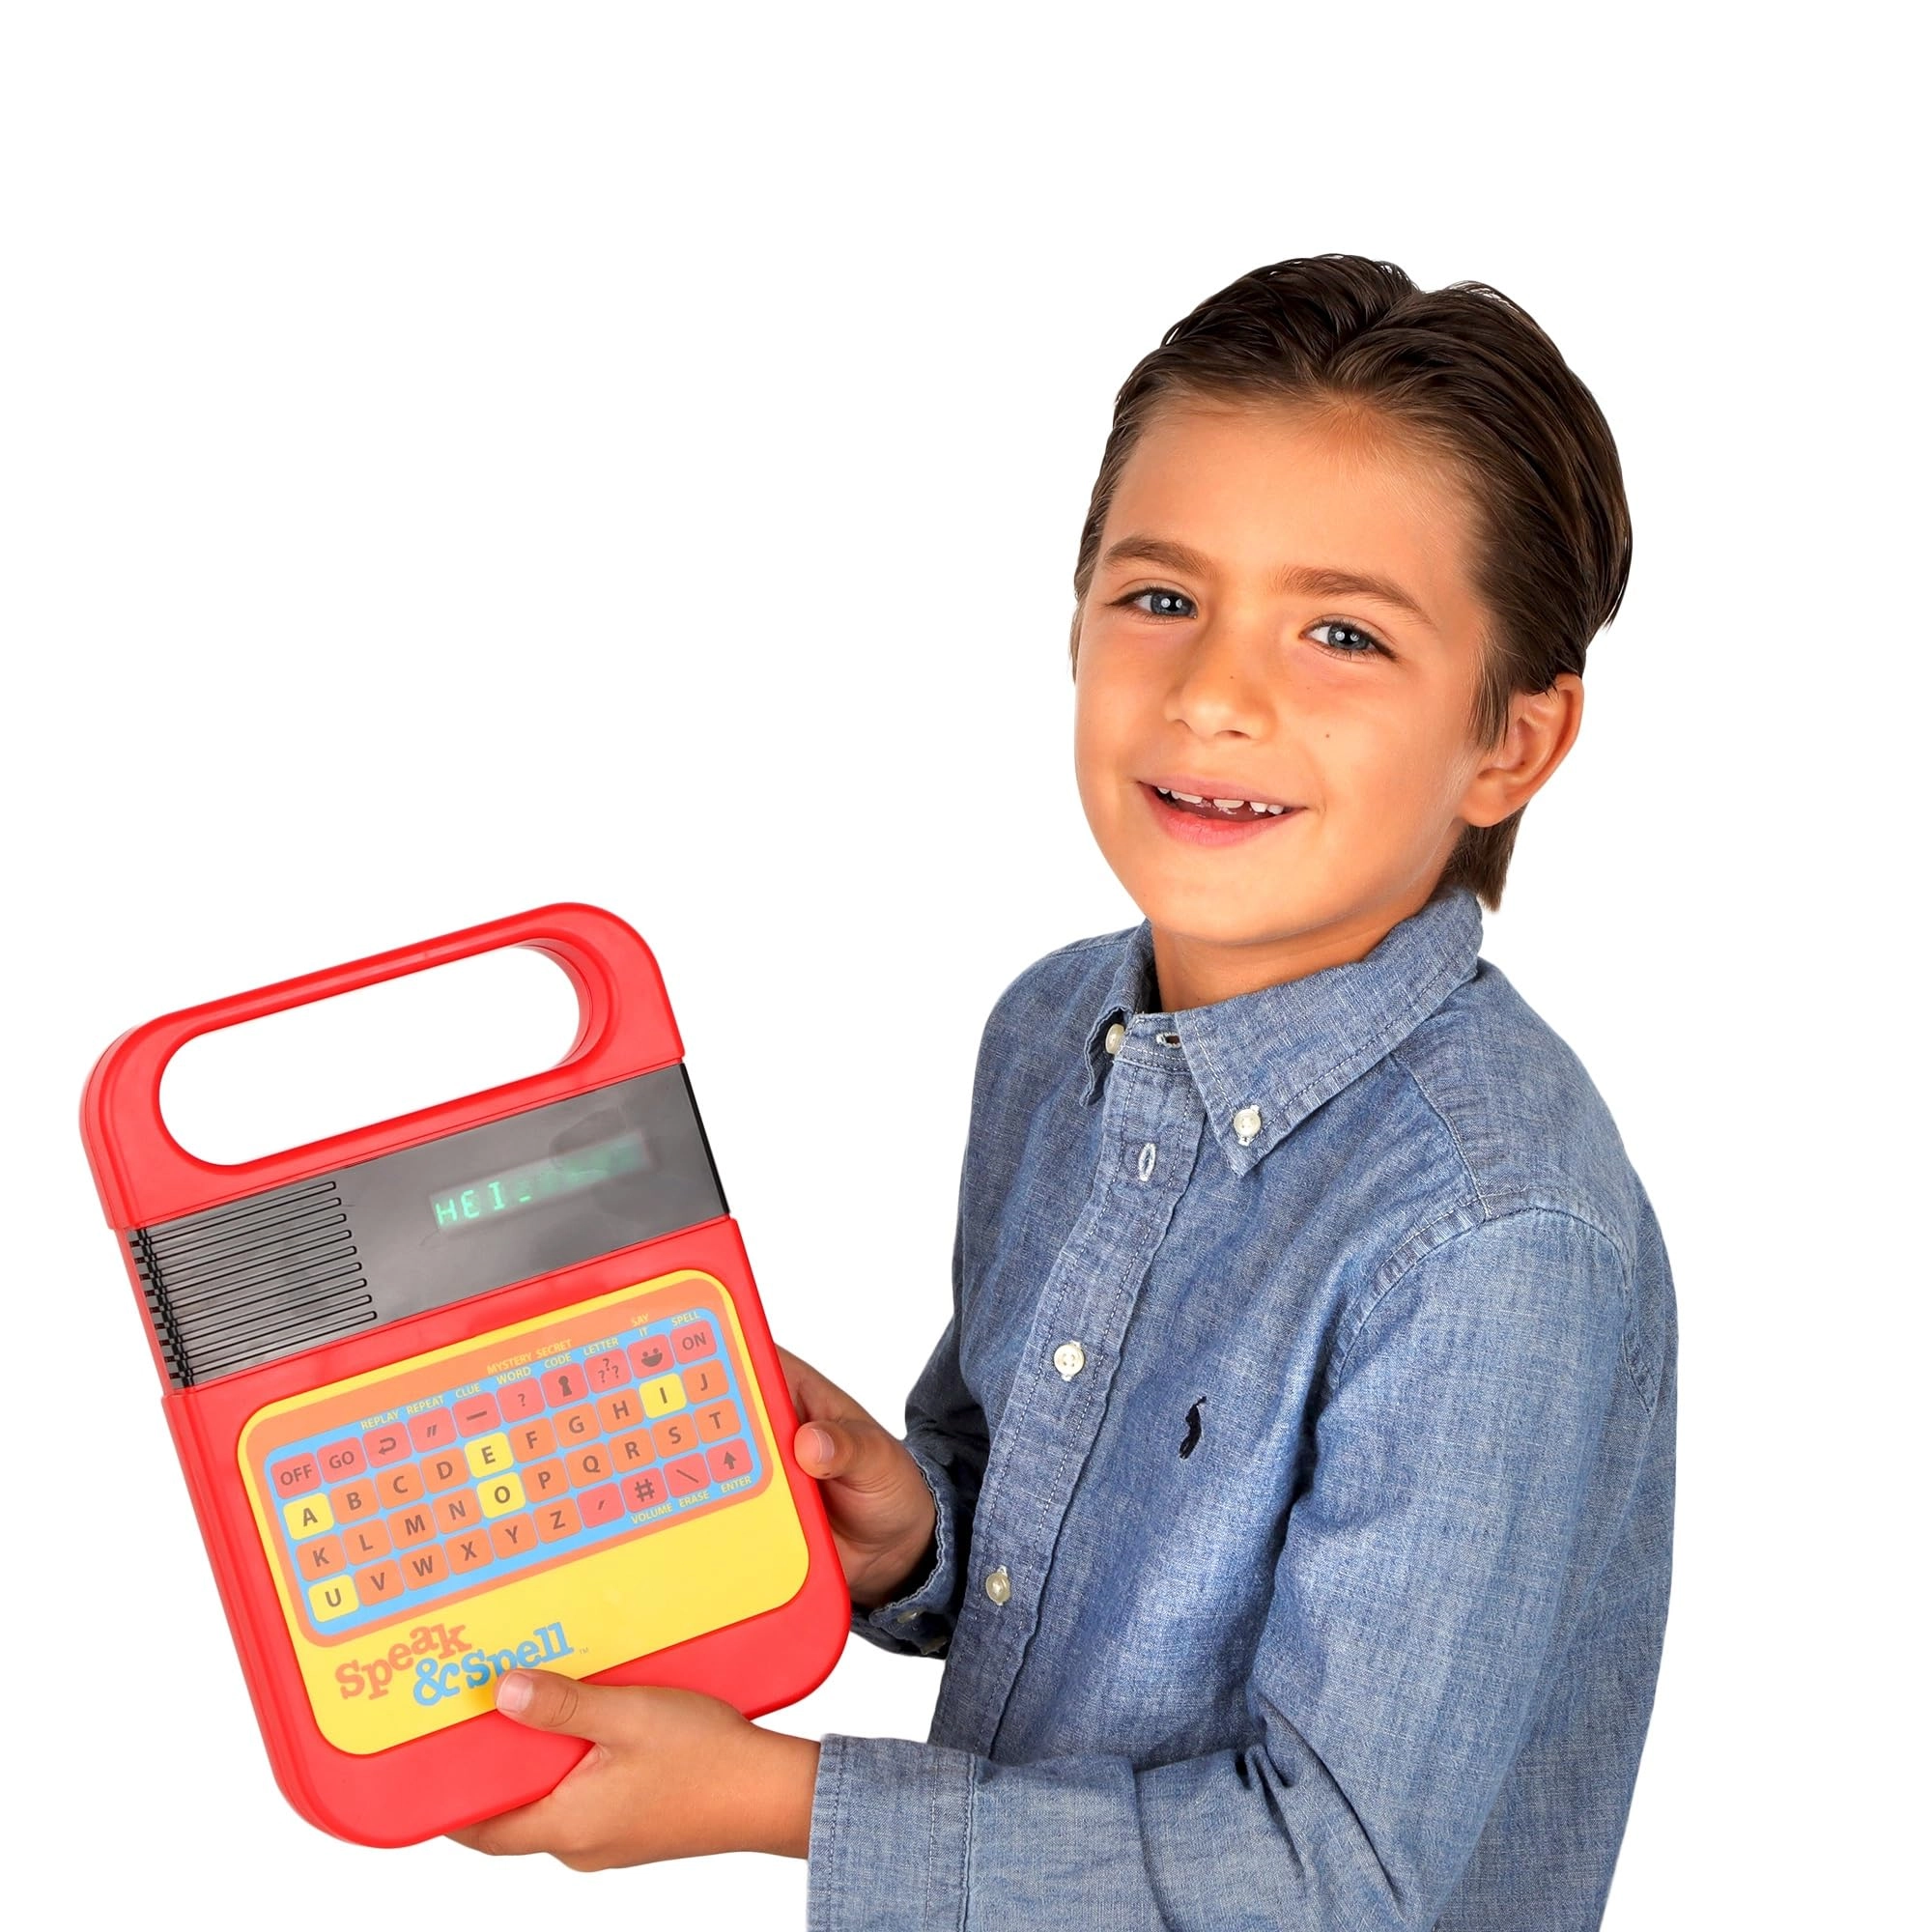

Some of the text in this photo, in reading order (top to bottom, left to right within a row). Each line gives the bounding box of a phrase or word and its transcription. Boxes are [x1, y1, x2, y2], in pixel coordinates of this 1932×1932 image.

[632, 1313, 650, 1327] SAY
[670, 1311, 700, 1327] SPELL
[639, 1327, 649, 1338] IT
[681, 1332, 708, 1351] ON
[536, 1339, 573, 1358] SECRET
[582, 1337, 619, 1356] LETTER
[486, 1352, 532, 1376] MYSTERY
[544, 1353, 573, 1370] CODE
[497, 1366, 532, 1385] WORD
[455, 1382, 481, 1400] CLUE
[406, 1395, 445, 1415] REPEAT
[360, 1409, 400, 1431] REPLAY
[302, 1373, 709, 1527] A B C D E F G H I J
[328, 1450, 355, 1470] GO
[279, 1463, 314, 1486] OFF
[312, 1411, 722, 1567] K L M N O P Q R S T
[721, 1476, 752, 1493] ENTER
[678, 1491, 710, 1508] ERASE
[630, 1502, 673, 1524] VOLUME
[325, 1510, 566, 1607] U V W X Y Z
[334, 1623, 473, 1700] Speak
